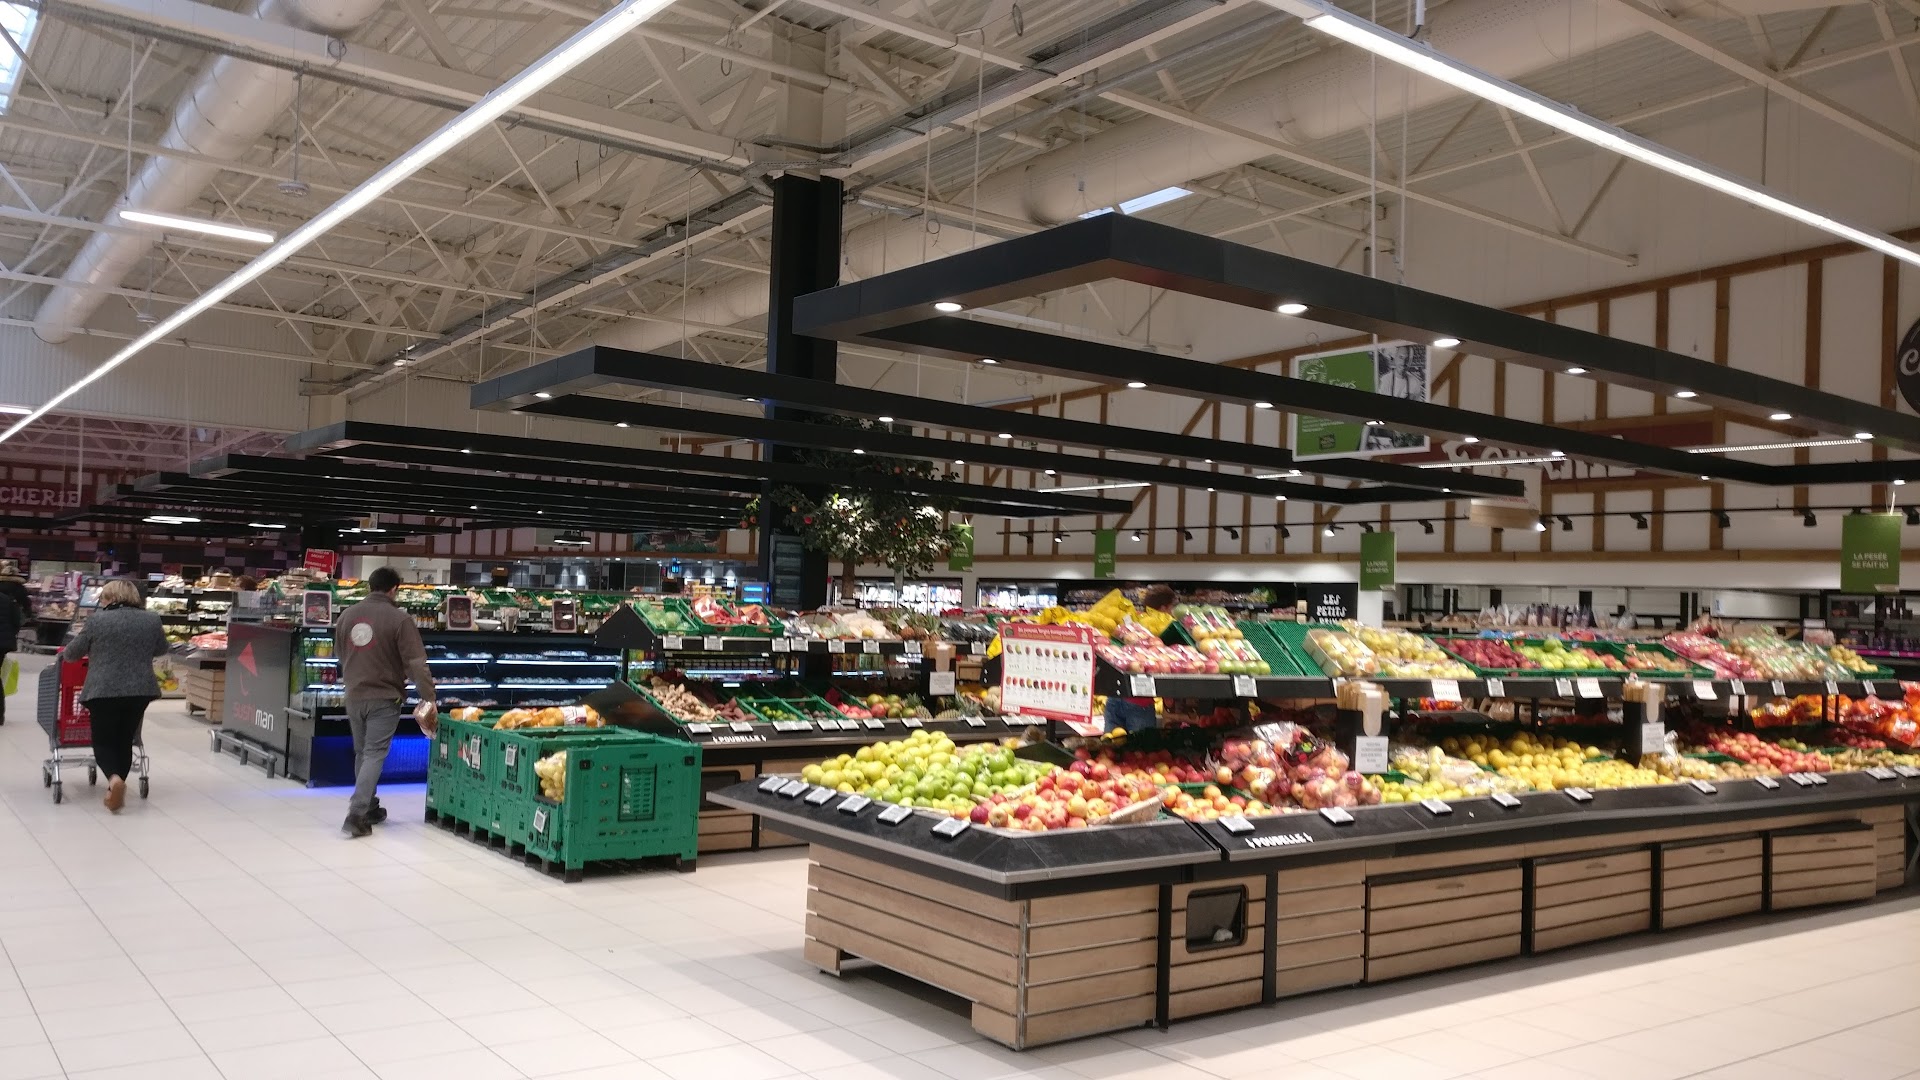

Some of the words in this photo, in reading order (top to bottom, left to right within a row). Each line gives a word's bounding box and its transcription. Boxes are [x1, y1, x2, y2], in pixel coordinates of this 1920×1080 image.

[1323, 594, 1341, 606] LES
[1316, 605, 1347, 618] PETITS
[718, 735, 762, 743] POUBELLE
[1252, 833, 1307, 848] POUBELLE
